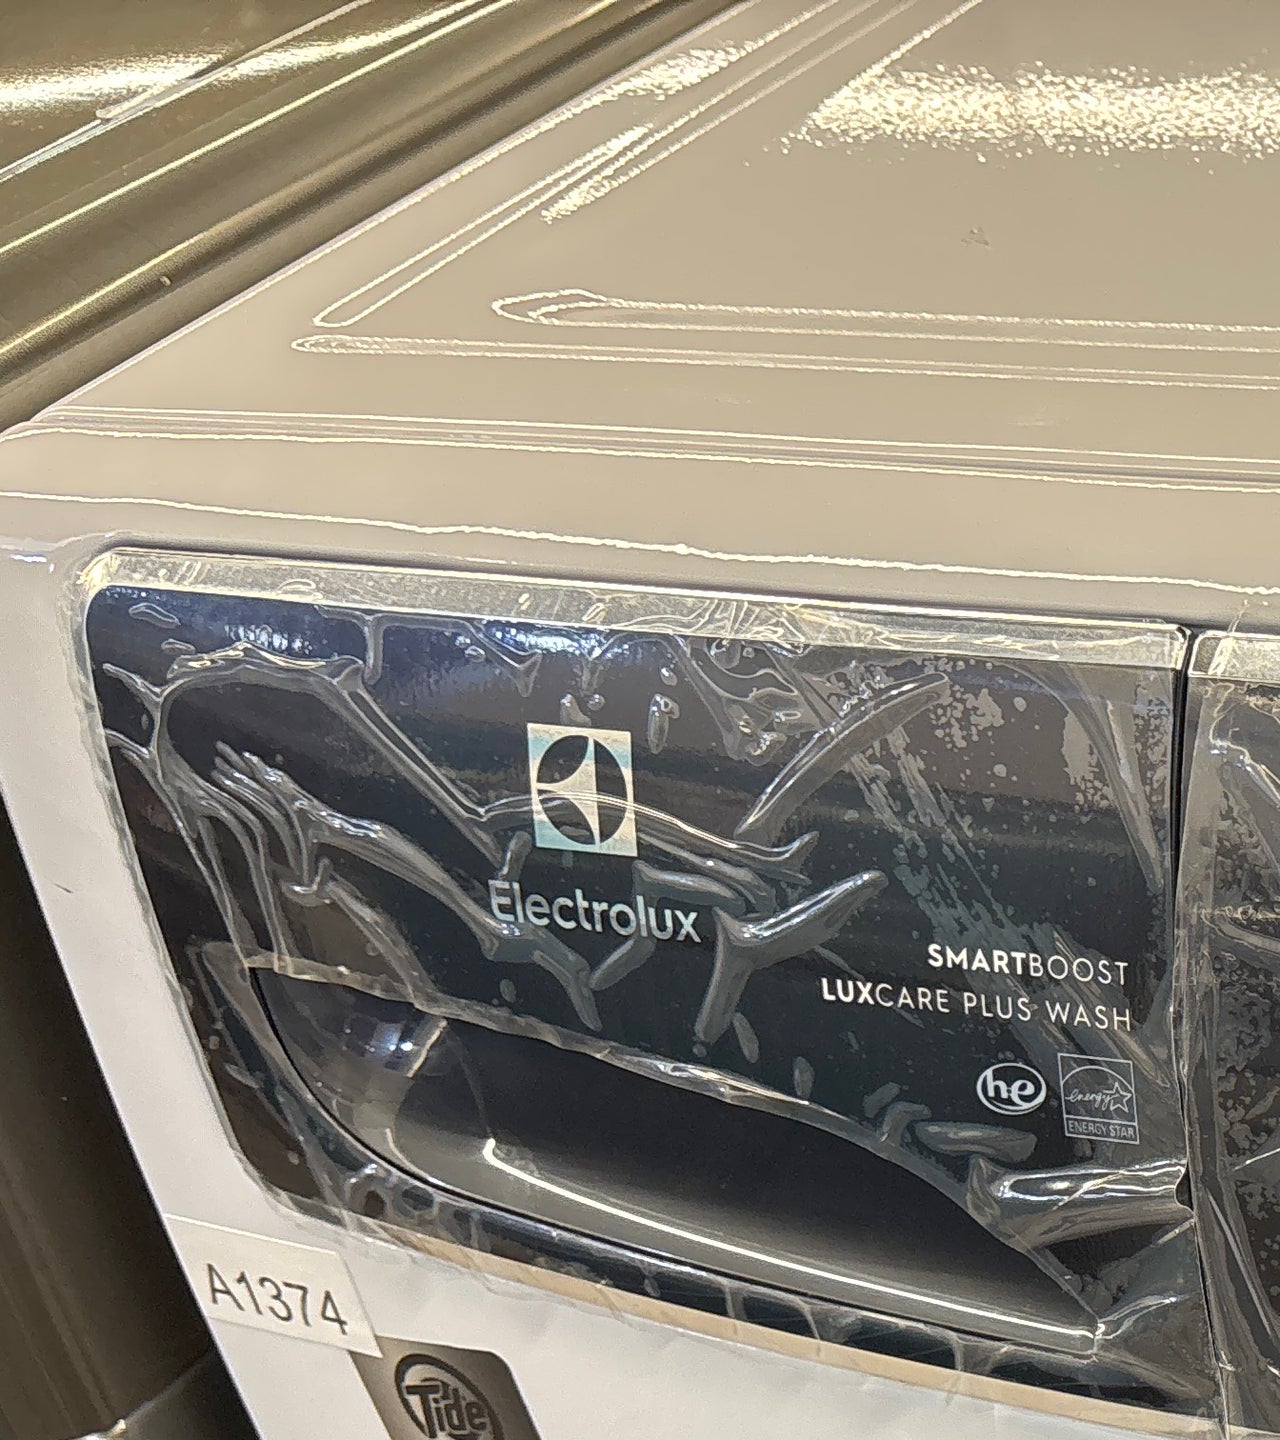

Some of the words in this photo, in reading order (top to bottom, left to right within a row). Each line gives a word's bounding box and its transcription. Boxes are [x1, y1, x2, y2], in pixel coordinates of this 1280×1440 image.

[488, 879, 701, 944] Electrolux
[927, 943, 1130, 986] SMARTBOOST
[820, 977, 951, 1014] LUXCARE
[963, 992, 1032, 1022] PLUS
[1044, 1000, 1133, 1031] WASH
[1067, 1120, 1107, 1136] ENERGY
[1109, 1122, 1135, 1139] STAR
[206, 1261, 350, 1336] A1374
[405, 1383, 490, 1440] Tide
